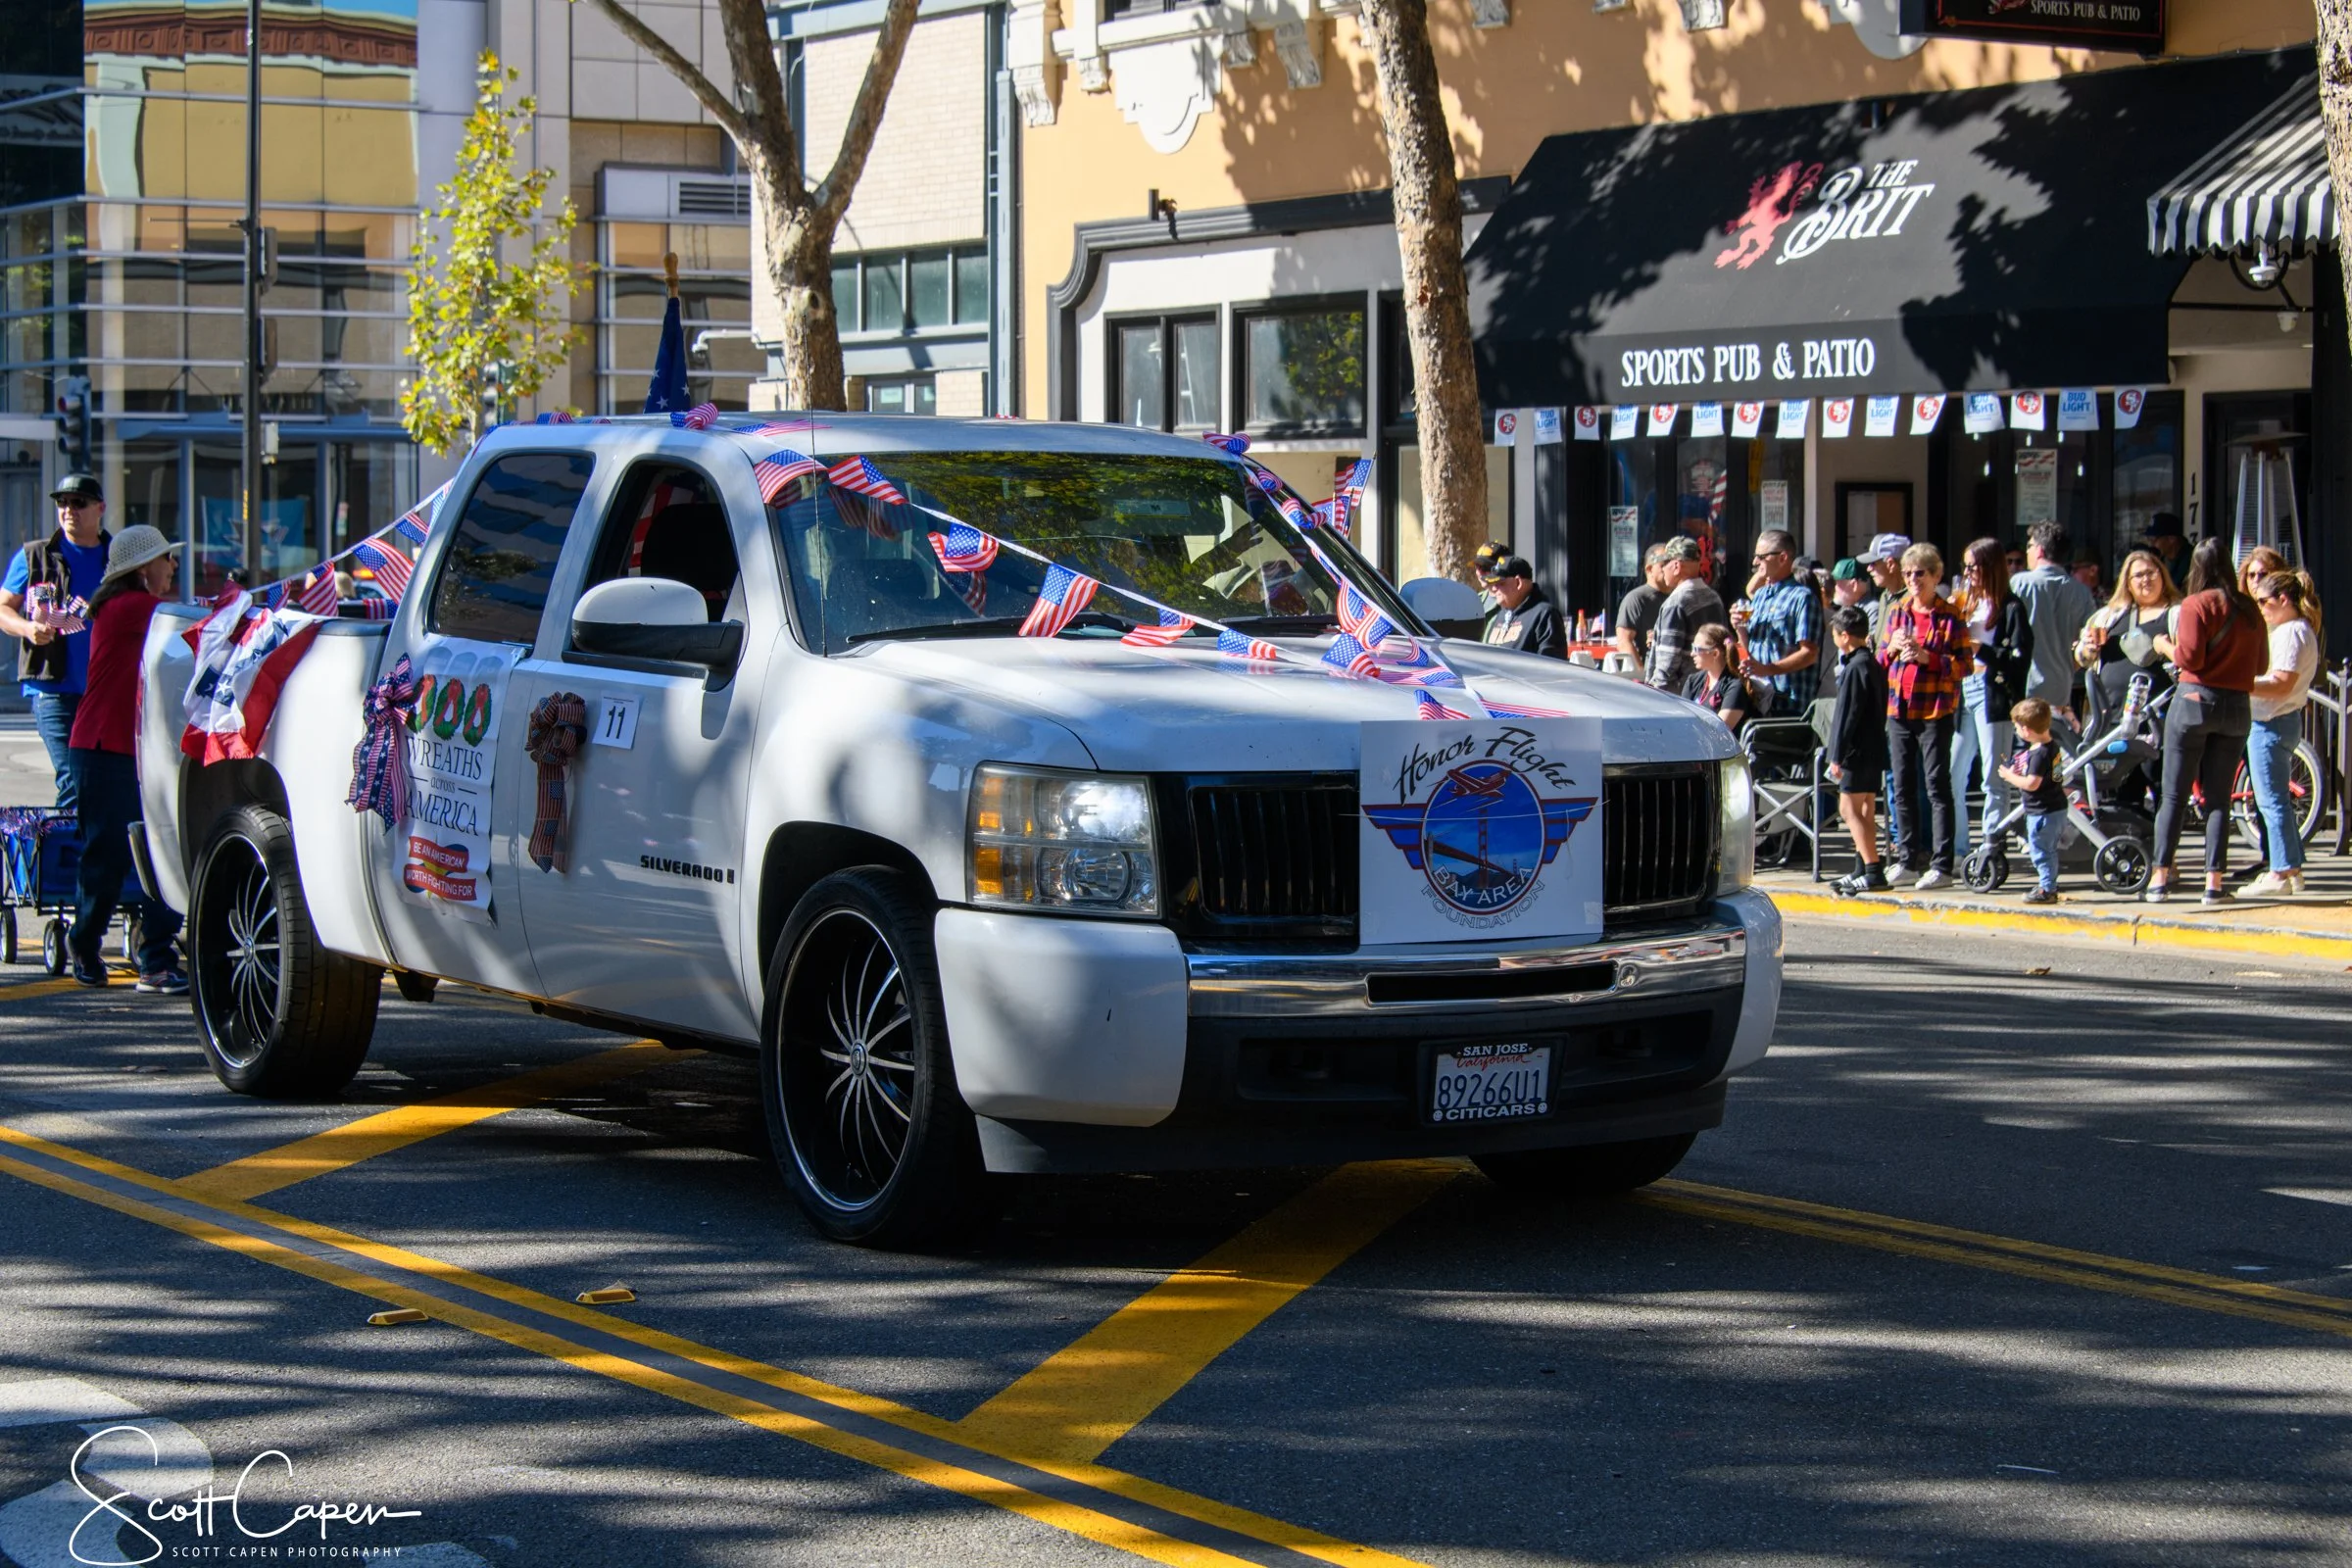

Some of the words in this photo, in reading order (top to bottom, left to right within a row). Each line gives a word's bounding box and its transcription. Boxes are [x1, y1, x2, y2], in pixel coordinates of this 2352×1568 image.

[2030, 0, 2071, 17] SPORTS
[2073, 2, 2095, 18] PUB
[2097, 4, 2108, 19] &
[2110, 5, 2141, 22] PATIO
[1866, 160, 1919, 189] THE
[1775, 166, 1936, 266] BRIT
[1621, 347, 1706, 388] SPORTS
[1713, 344, 1762, 383] PUB
[1772, 342, 1795, 381] &
[1801, 337, 1876, 379] PATIO
[2062, 402, 2090, 413] LIGHT
[2067, 392, 2086, 402] BUD
[1540, 410, 1555, 418] BUD
[1615, 412, 1635, 422] LIGHT
[1696, 410, 1718, 419] LIGHT
[1783, 412, 1804, 420] LIGHT
[1871, 409, 1893, 417] LIGHT
[1967, 403, 1993, 415] LIGHT
[1537, 418, 1558, 428] LIGHT
[606, 705, 626, 740] 11
[405, 735, 483, 781] WREATHS
[1393, 734, 1476, 807] Honor
[1485, 726, 1576, 790] Flight
[430, 776, 456, 793] across
[405, 790, 479, 836] AMERICA
[413, 842, 422, 854] BE
[421, 846, 431, 858] AN
[431, 849, 466, 868] AMERICAN
[640, 855, 723, 883] SILVERADO
[406, 869, 427, 883] WORTH
[427, 875, 458, 895] FIGHTING
[458, 885, 472, 897] FOR
[1433, 863, 1474, 901] BAY
[1477, 866, 1534, 905] AREA
[1421, 880, 1545, 930] FOUNDATION
[1463, 1045, 1492, 1056] SAN
[1495, 1043, 1529, 1055] JOSE
[1456, 1054, 1532, 1071] California
[1438, 1069, 1543, 1108] 89266U1
[1446, 1103, 1536, 1121] CITICARS
